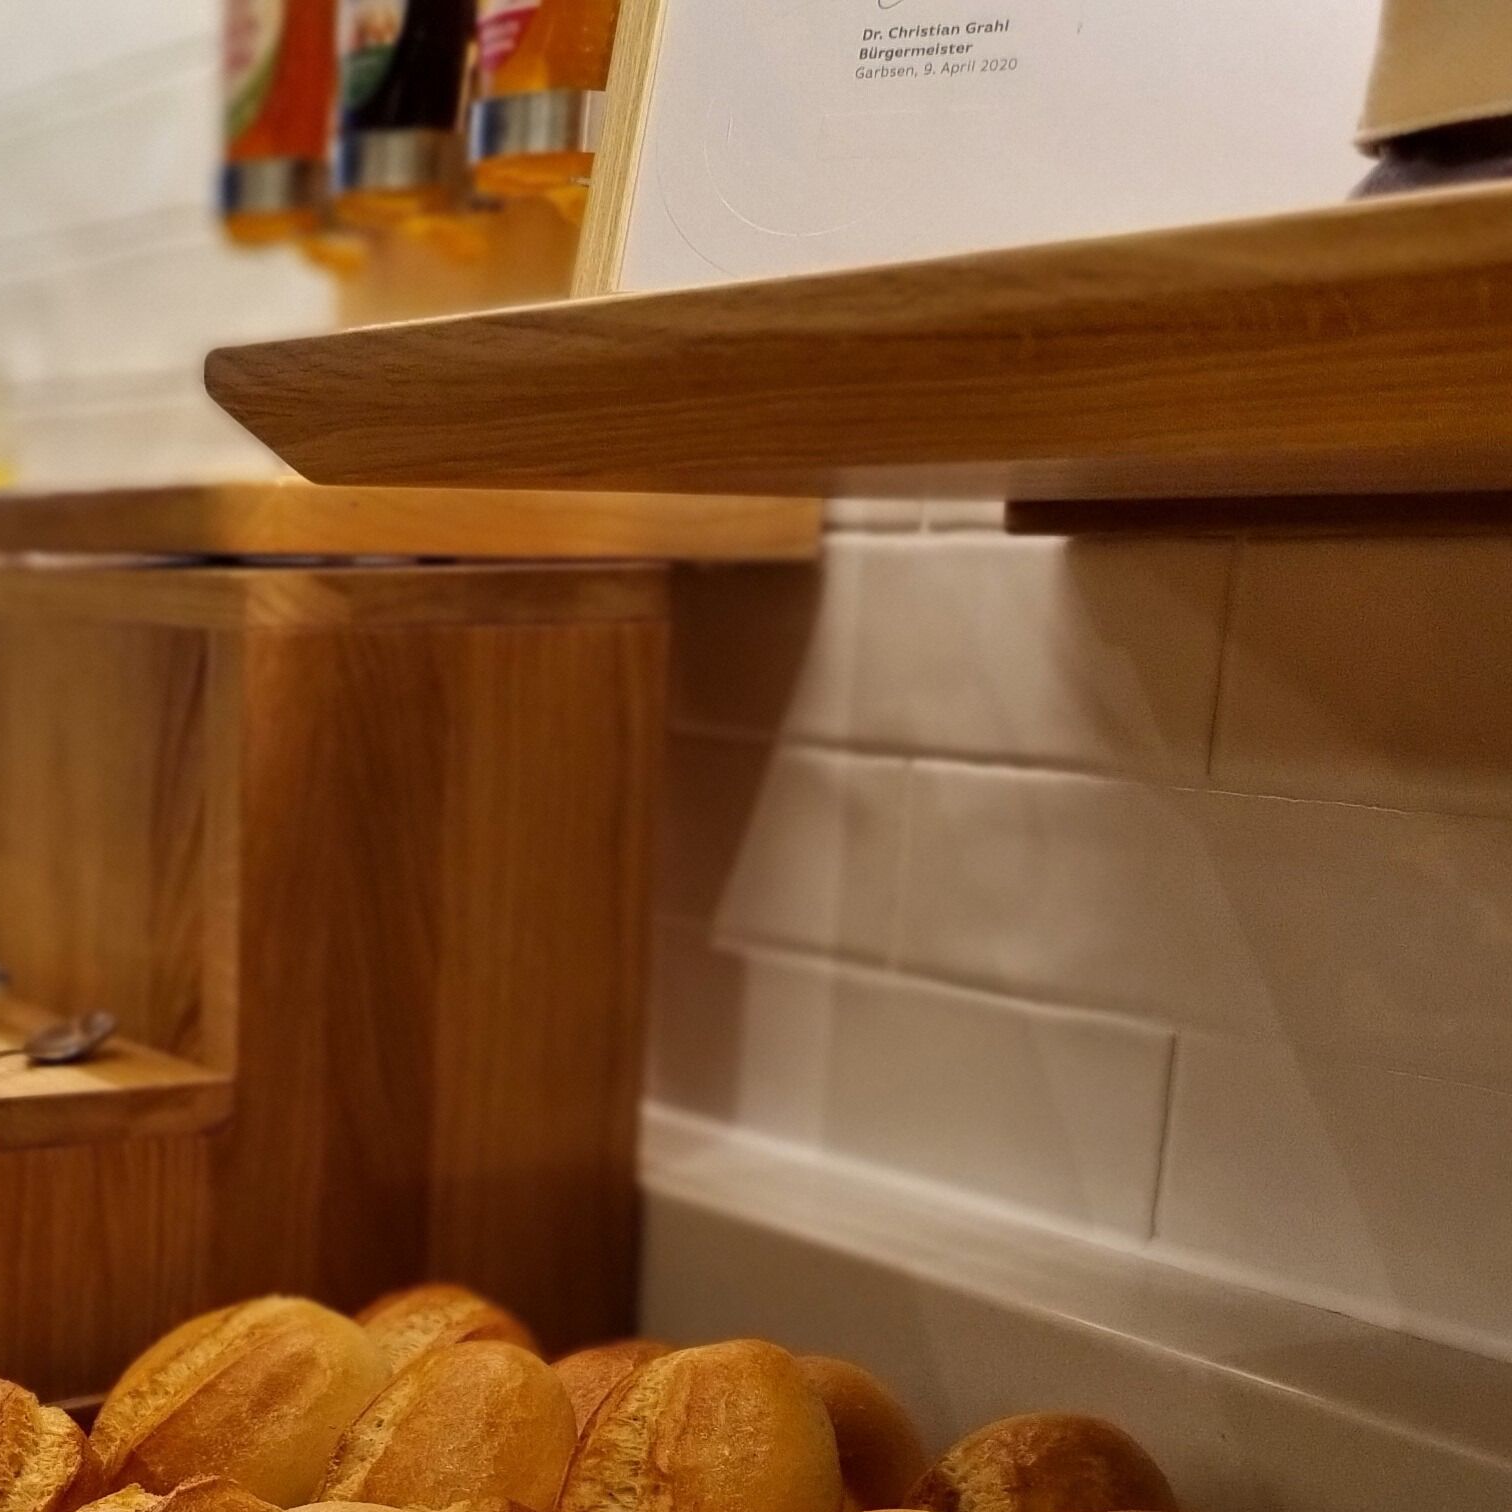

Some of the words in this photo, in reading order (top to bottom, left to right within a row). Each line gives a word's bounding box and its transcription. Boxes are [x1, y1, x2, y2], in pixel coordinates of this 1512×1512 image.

[862, 28, 883, 41] Dr.
[888, 24, 960, 39] Christian
[966, 19, 1010, 34] Grahl
[859, 43, 973, 61] Bürgermeister
[855, 65, 918, 80] Garbsen,
[923, 63, 935, 76] 9.
[941, 60, 976, 77] April
[981, 58, 1018, 72] 2020
